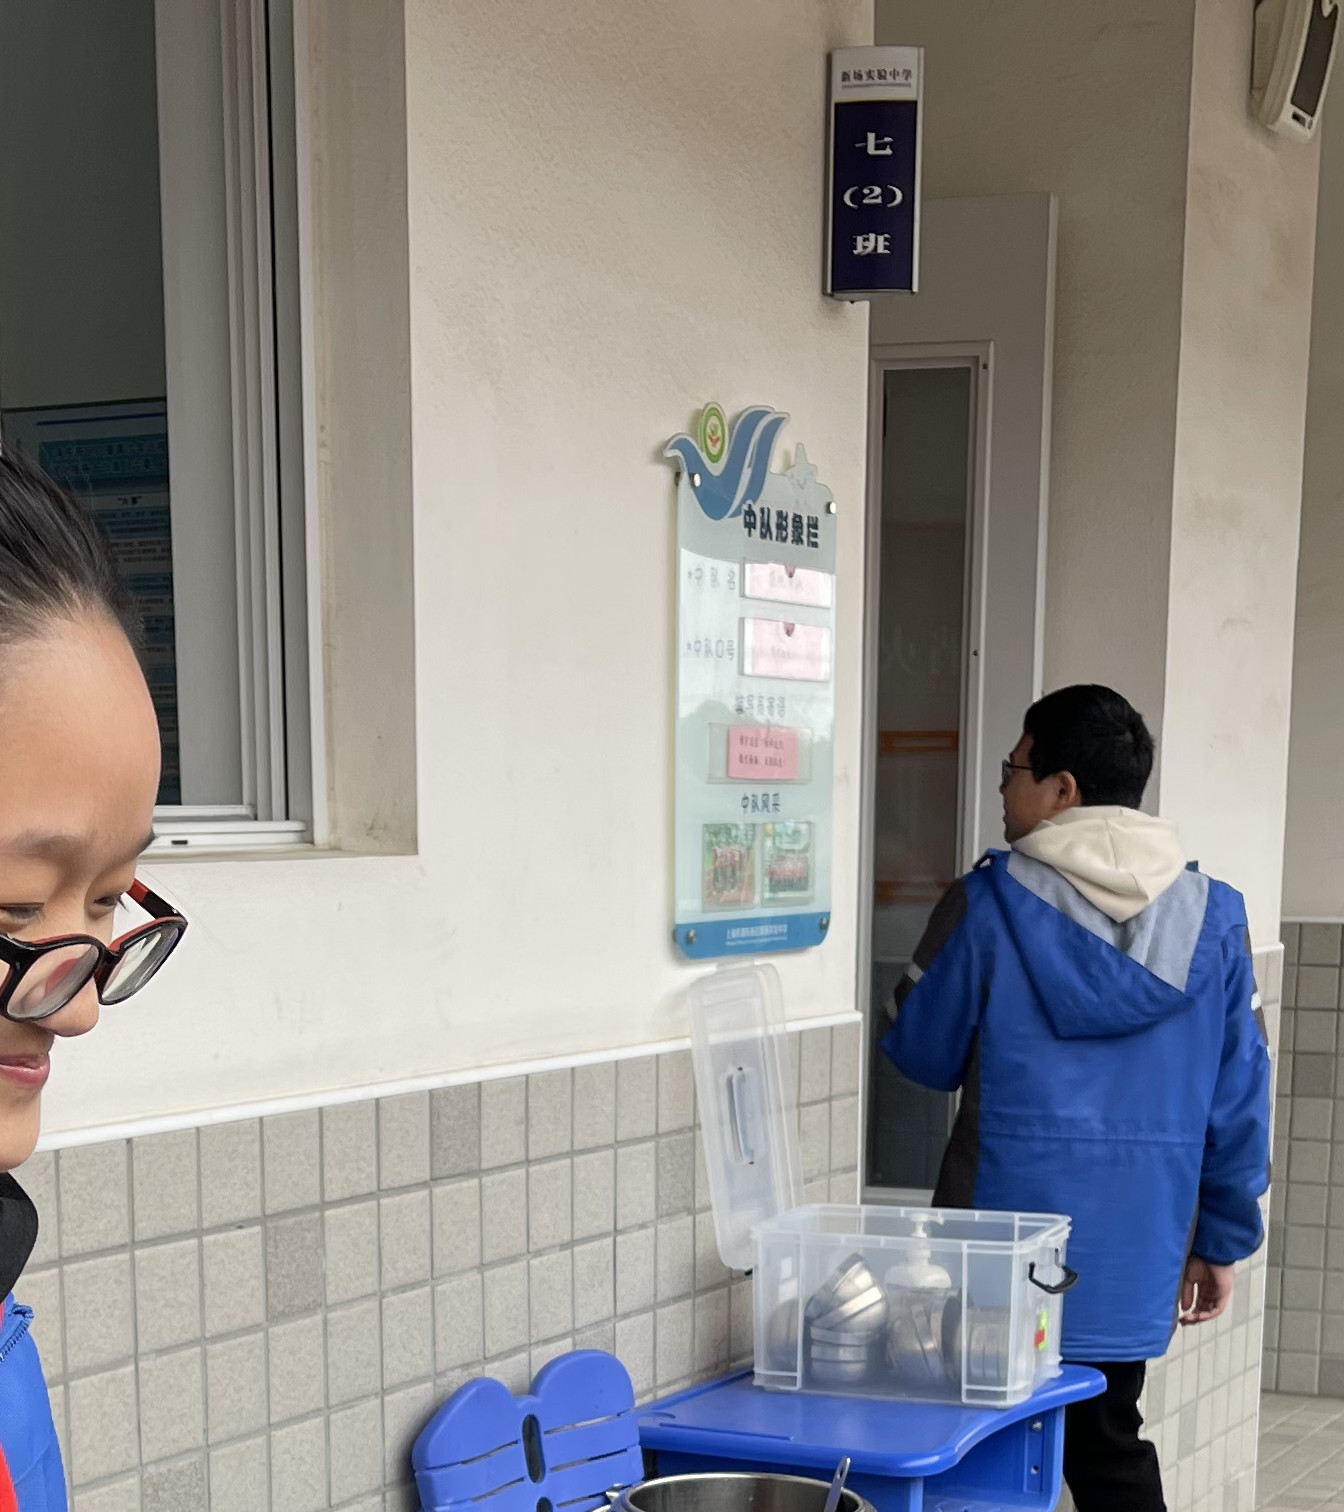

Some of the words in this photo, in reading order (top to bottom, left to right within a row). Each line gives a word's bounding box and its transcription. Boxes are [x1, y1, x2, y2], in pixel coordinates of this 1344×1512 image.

[743, 503, 819, 548] 中队形象栏
[741, 792, 781, 813] 中队风采
